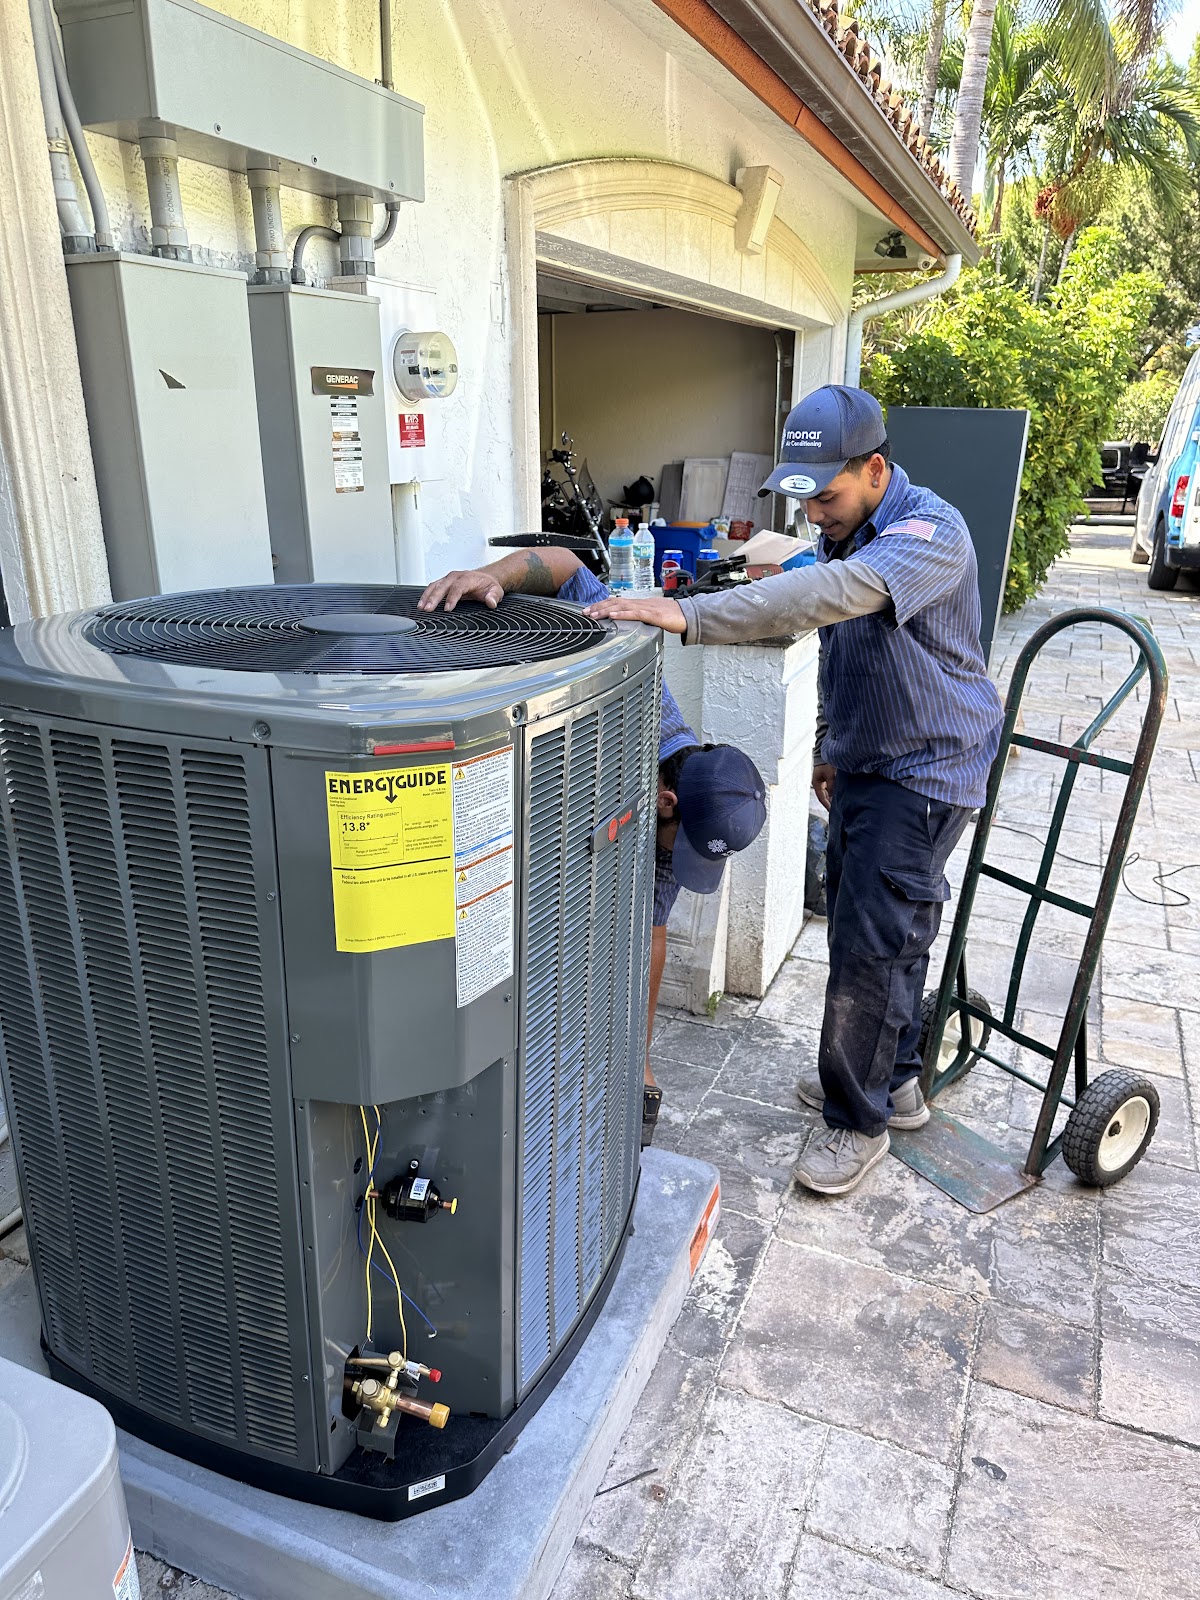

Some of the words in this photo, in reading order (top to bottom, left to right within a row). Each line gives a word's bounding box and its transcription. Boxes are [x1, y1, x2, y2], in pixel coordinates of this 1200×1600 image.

[165, 183, 175, 213] CONDUIT
[268, 229, 276, 243] AND
[326, 374, 359, 384] GENERAC
[786, 430, 823, 440] monar
[791, 440, 822, 448] Conditioning
[329, 771, 447, 794] ENERGYGUIDE
